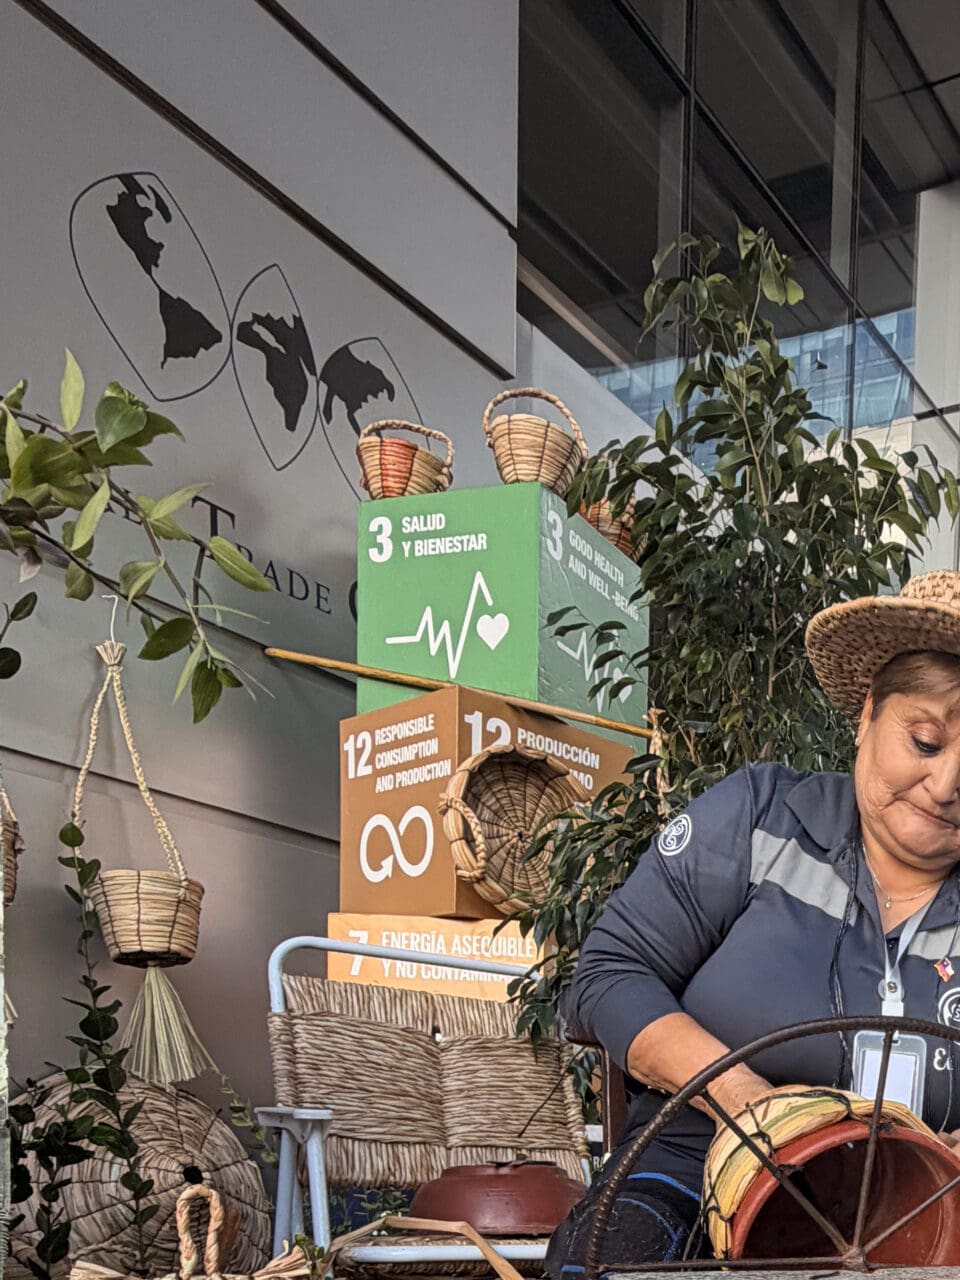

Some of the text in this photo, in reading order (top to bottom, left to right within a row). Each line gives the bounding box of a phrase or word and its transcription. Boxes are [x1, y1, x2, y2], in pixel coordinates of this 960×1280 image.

[368, 516, 393, 563] 3
[401, 513, 446, 534] SALUD
[546, 510, 563, 562] 3
[402, 533, 487, 558] Y BIENESTAR
[569, 530, 624, 588] GOOD HEALTH
[568, 556, 587, 581] AND
[588, 568, 610, 600] WELL
[374, 713, 435, 746] RESPONSIBLE
[517, 727, 600, 770] PRODUCCIÓN
[343, 731, 373, 779] 12
[375, 737, 439, 769] CONSUMPTION
[375, 758, 452, 793] AND PRODUCTION
[348, 929, 369, 976] 7
[381, 930, 535, 959] ENERGÍA ASEQUIBLE
